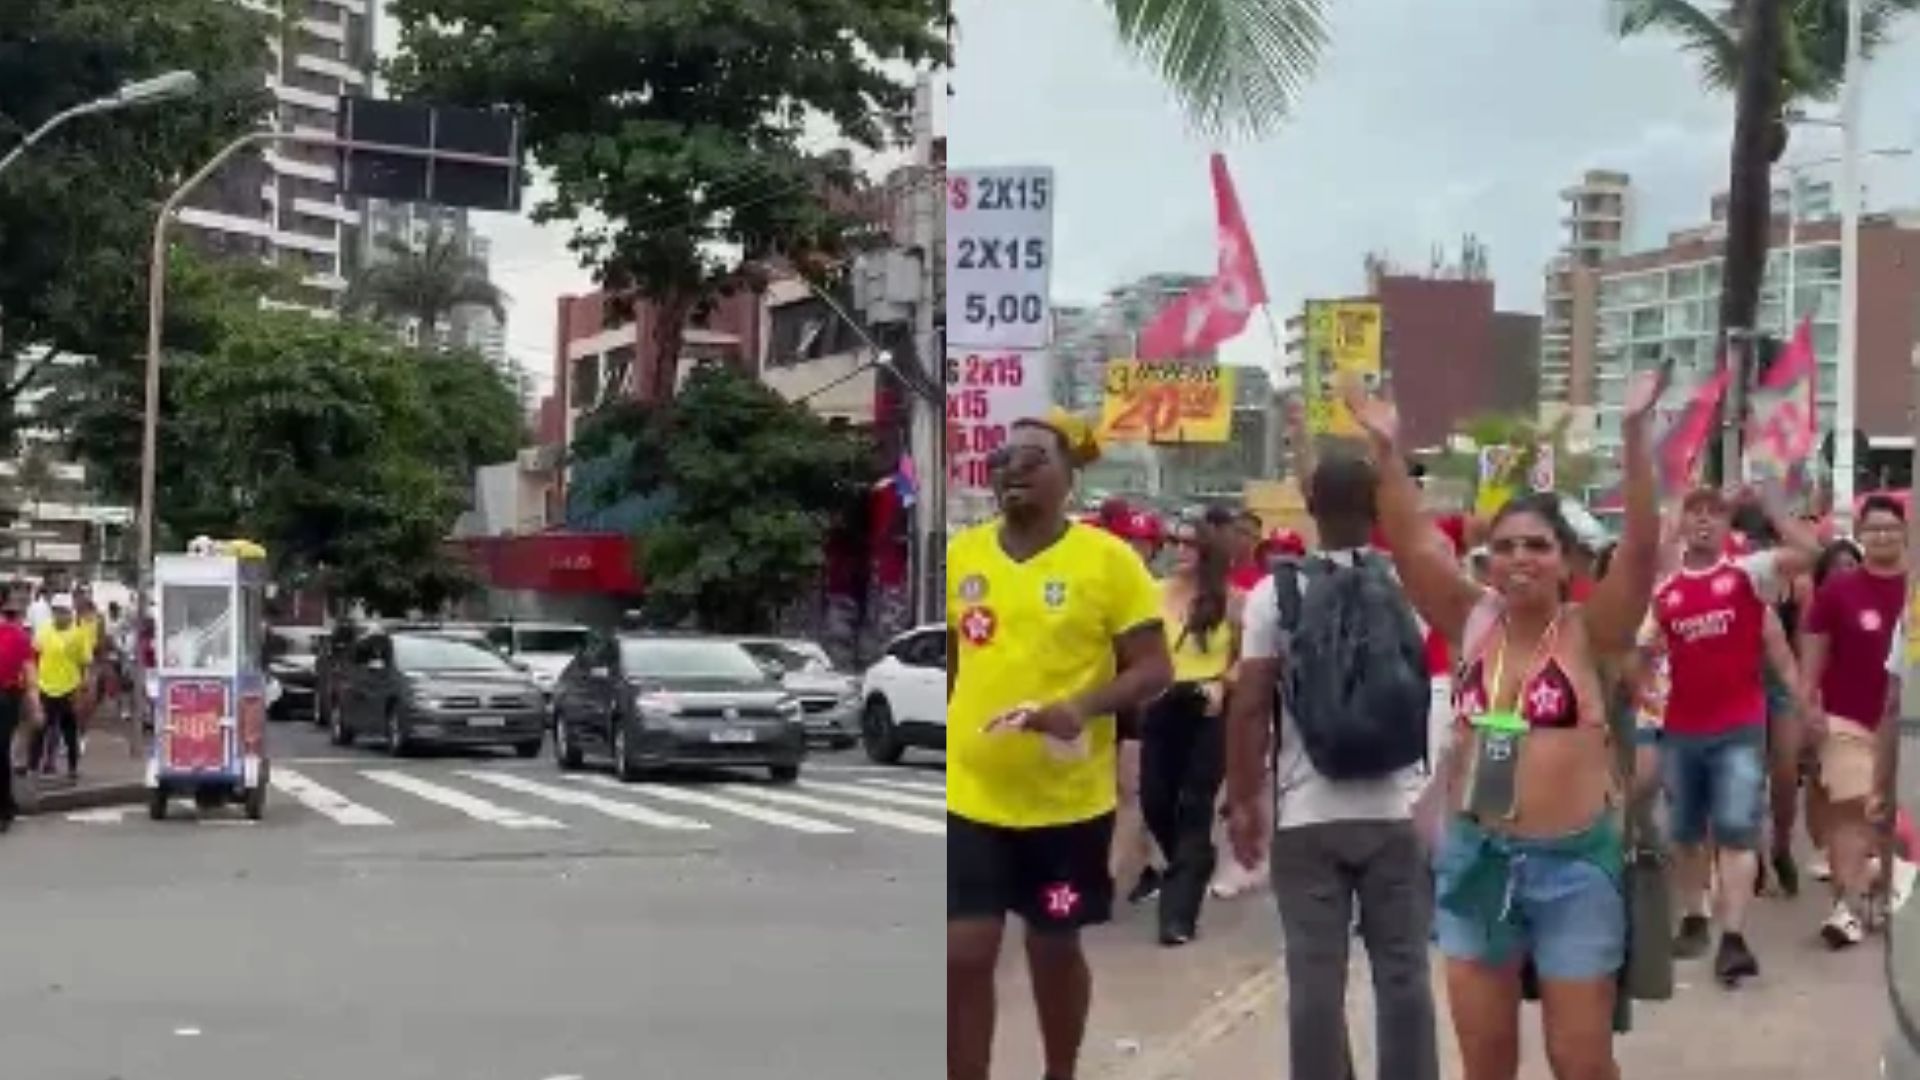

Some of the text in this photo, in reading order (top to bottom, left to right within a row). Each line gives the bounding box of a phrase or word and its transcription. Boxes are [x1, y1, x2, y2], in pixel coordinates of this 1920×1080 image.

[977, 177, 1046, 210] 2X15
[957, 237, 1043, 269] 2X15
[965, 294, 1042, 331] 5,00
